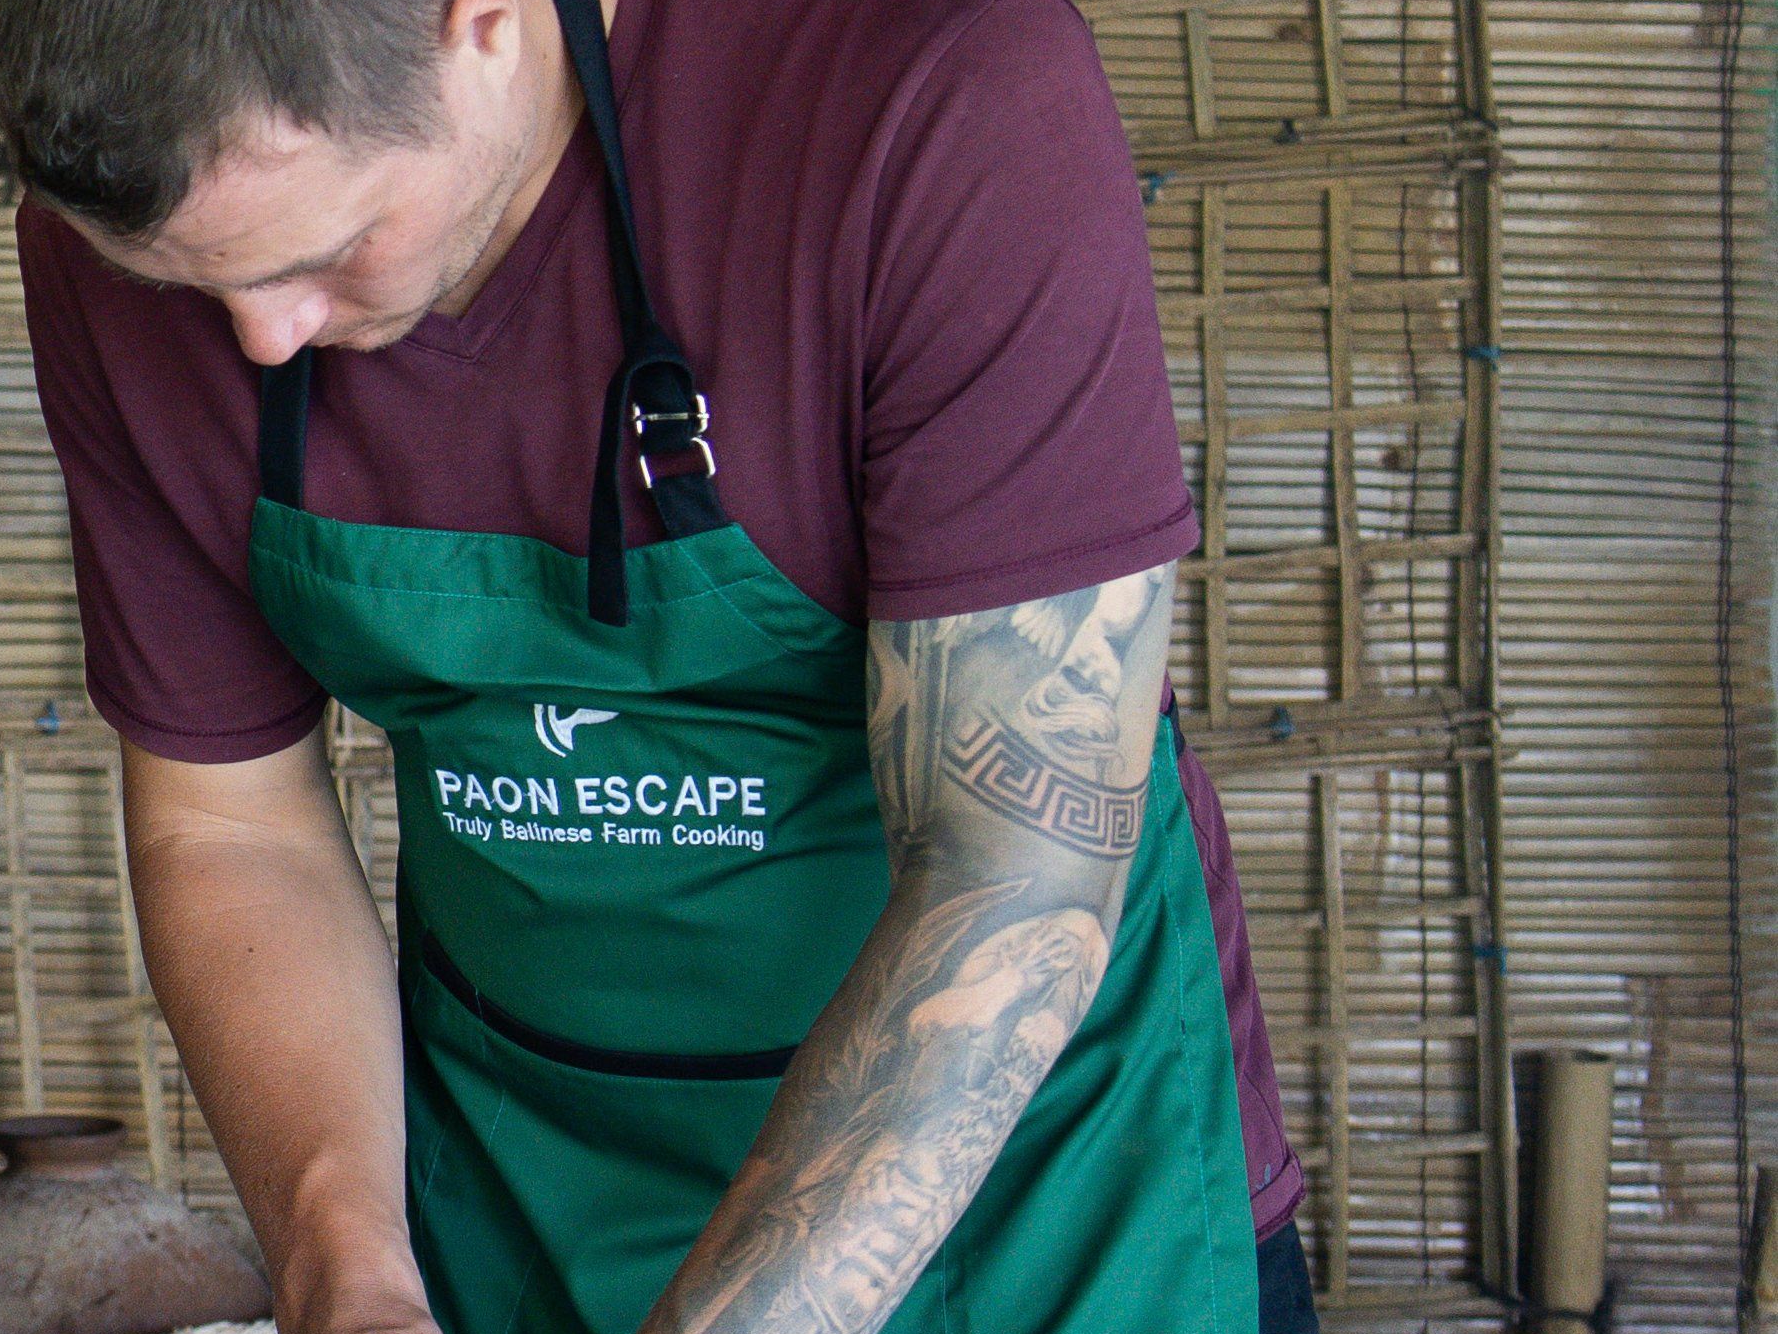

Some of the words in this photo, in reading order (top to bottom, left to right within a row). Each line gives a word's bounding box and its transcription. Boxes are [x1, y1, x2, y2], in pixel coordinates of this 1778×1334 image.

[435, 769, 559, 816] PAON
[575, 775, 767, 817] ESCAPE
[442, 812, 492, 841] Truly
[501, 820, 593, 844] Balinese
[601, 822, 661, 846] Farm
[672, 823, 764, 852] Cooking
